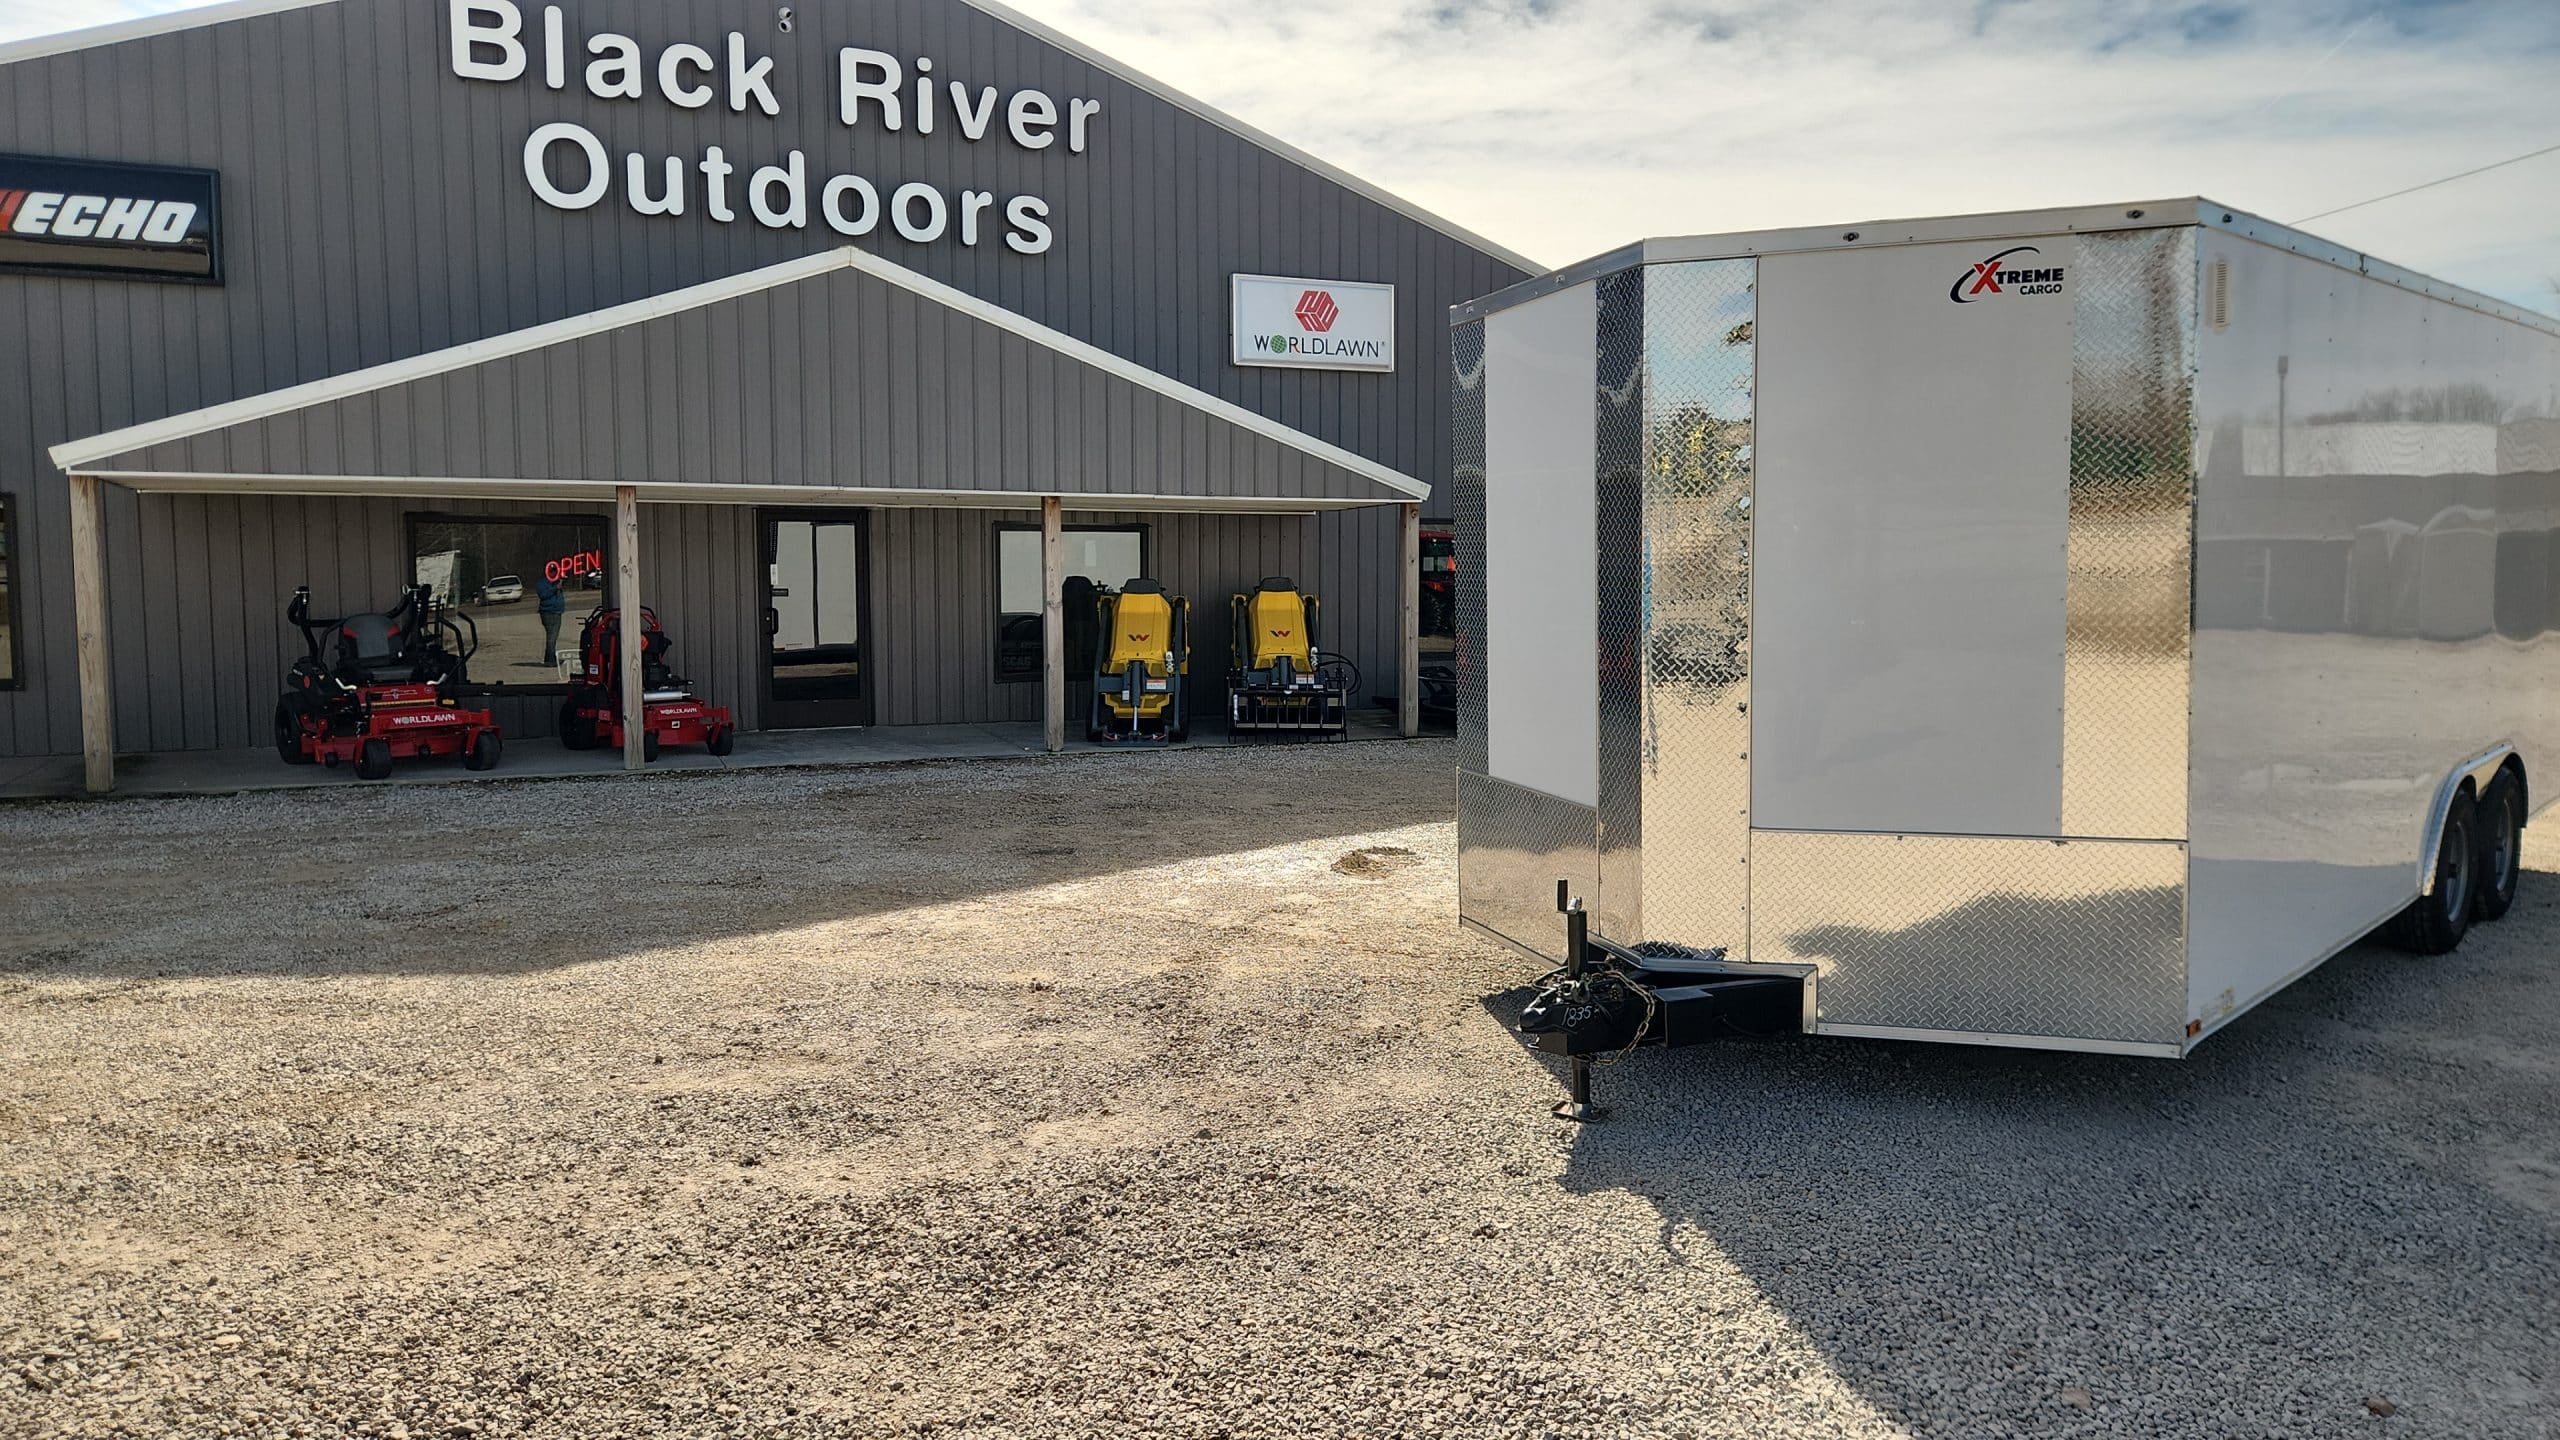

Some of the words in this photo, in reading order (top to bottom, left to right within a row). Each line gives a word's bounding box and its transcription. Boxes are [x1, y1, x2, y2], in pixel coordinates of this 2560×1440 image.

[450, 0, 780, 116] Black
[839, 46, 1100, 153] River
[523, 122, 1053, 255] Outdoors
[12, 191, 197, 243] ECHO
[1969, 261, 2065, 295] XTREME
[2019, 284, 2063, 296] CARGO
[1254, 334, 1380, 358] WORLDLAWN
[545, 549, 602, 582] OPEN
[392, 713, 456, 725] WORLDLAWN
[659, 707, 698, 715] WORLDLAWN
[1561, 1005, 1592, 1027] 1835
